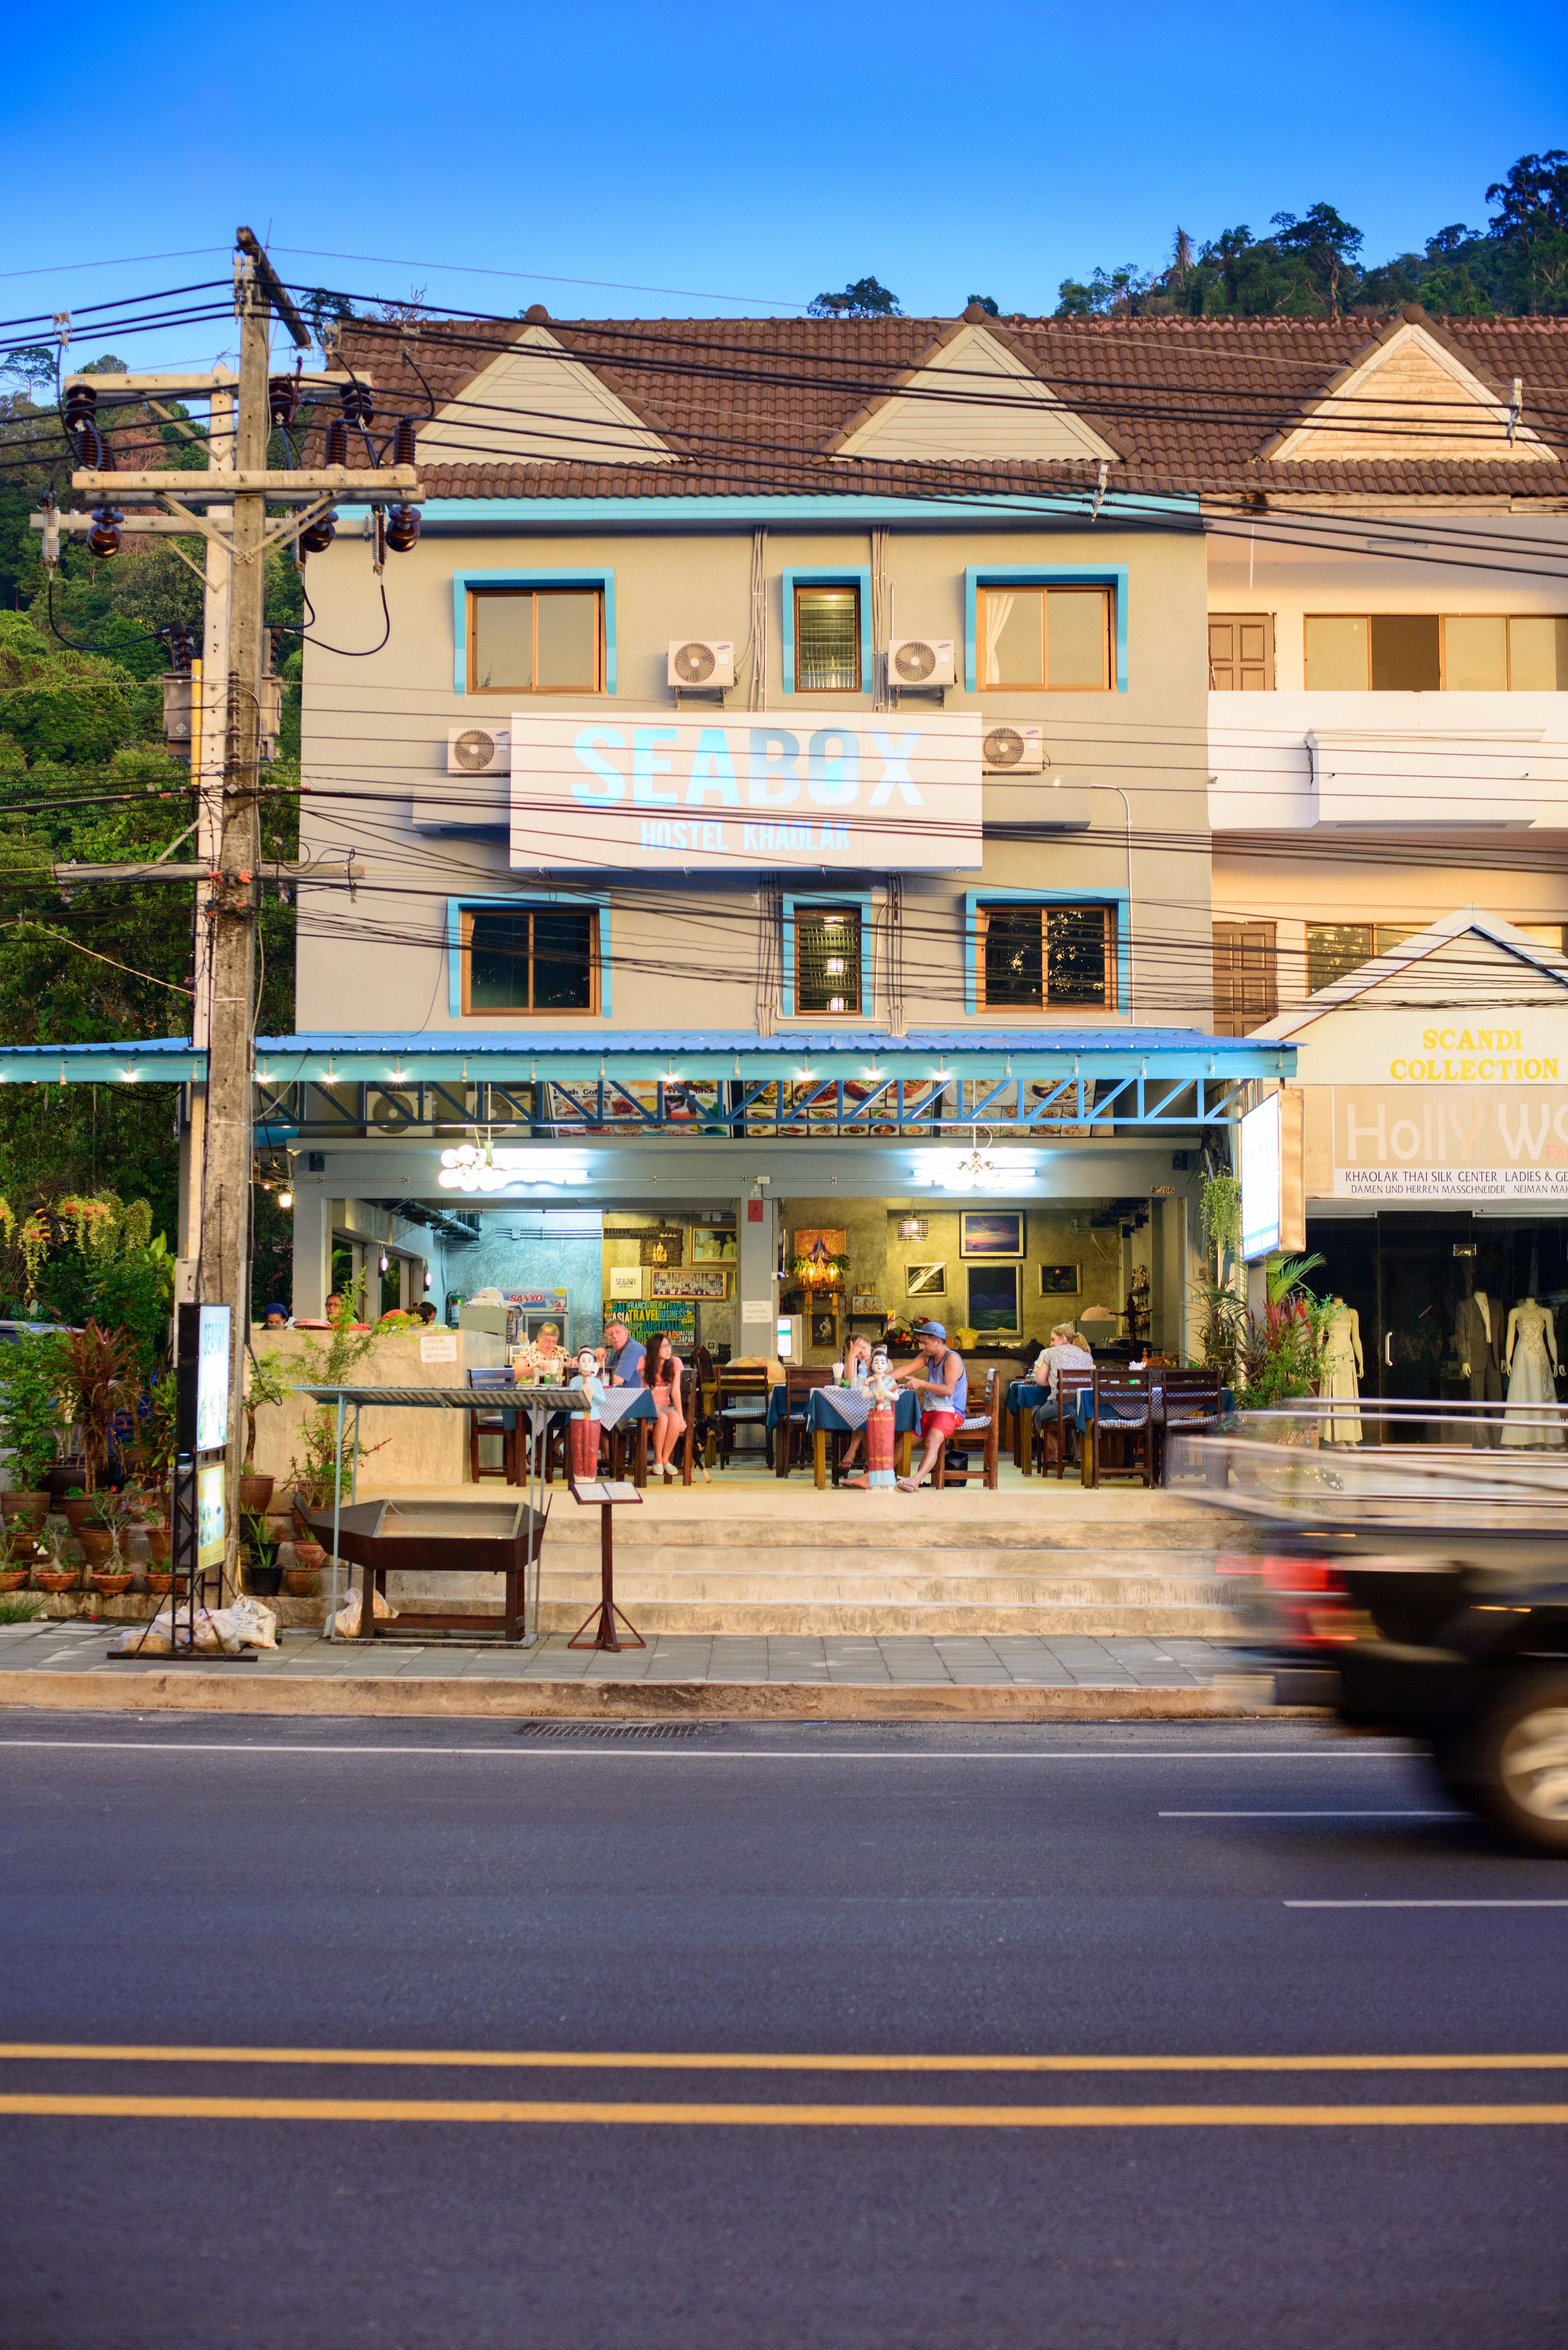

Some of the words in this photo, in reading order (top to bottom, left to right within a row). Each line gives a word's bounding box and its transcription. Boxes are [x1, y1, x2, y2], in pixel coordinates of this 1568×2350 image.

[570, 726, 925, 808] SEABOX
[641, 821, 729, 851] HOSTEL
[743, 819, 852, 851] KHAOLAK
[1422, 1029, 1523, 1051] SCANDI
[1390, 1058, 1559, 1081] COLLECTION
[1345, 1171, 1398, 1182] KHAOLAK
[1403, 1171, 1428, 1182] THAI
[1431, 1171, 1452, 1182] SILK
[1458, 1171, 1498, 1182] CENTER
[1505, 1171, 1541, 1182] LADIES
[1544, 1171, 1553, 1182] &
[1351, 1185, 1383, 1194] DAMEN
[1386, 1185, 1404, 1194] UND
[1406, 1185, 1439, 1194] HERREN
[1441, 1185, 1506, 1194] MASSCHNEIDER
[1514, 1185, 1548, 1194] NEIMAN
[613, 1302, 629, 1313] BALI
[628, 1301, 648, 1310] FRANCE
[649, 1301, 670, 1310] HOLIDAY
[612, 1311, 630, 1323] ASIA
[628, 1309, 660, 1322] TRAVEL
[658, 1310, 687, 1318] BUSINESS
[625, 1322, 643, 1330] UROPE
[643, 1321, 683, 1330] AUSTRALIA
